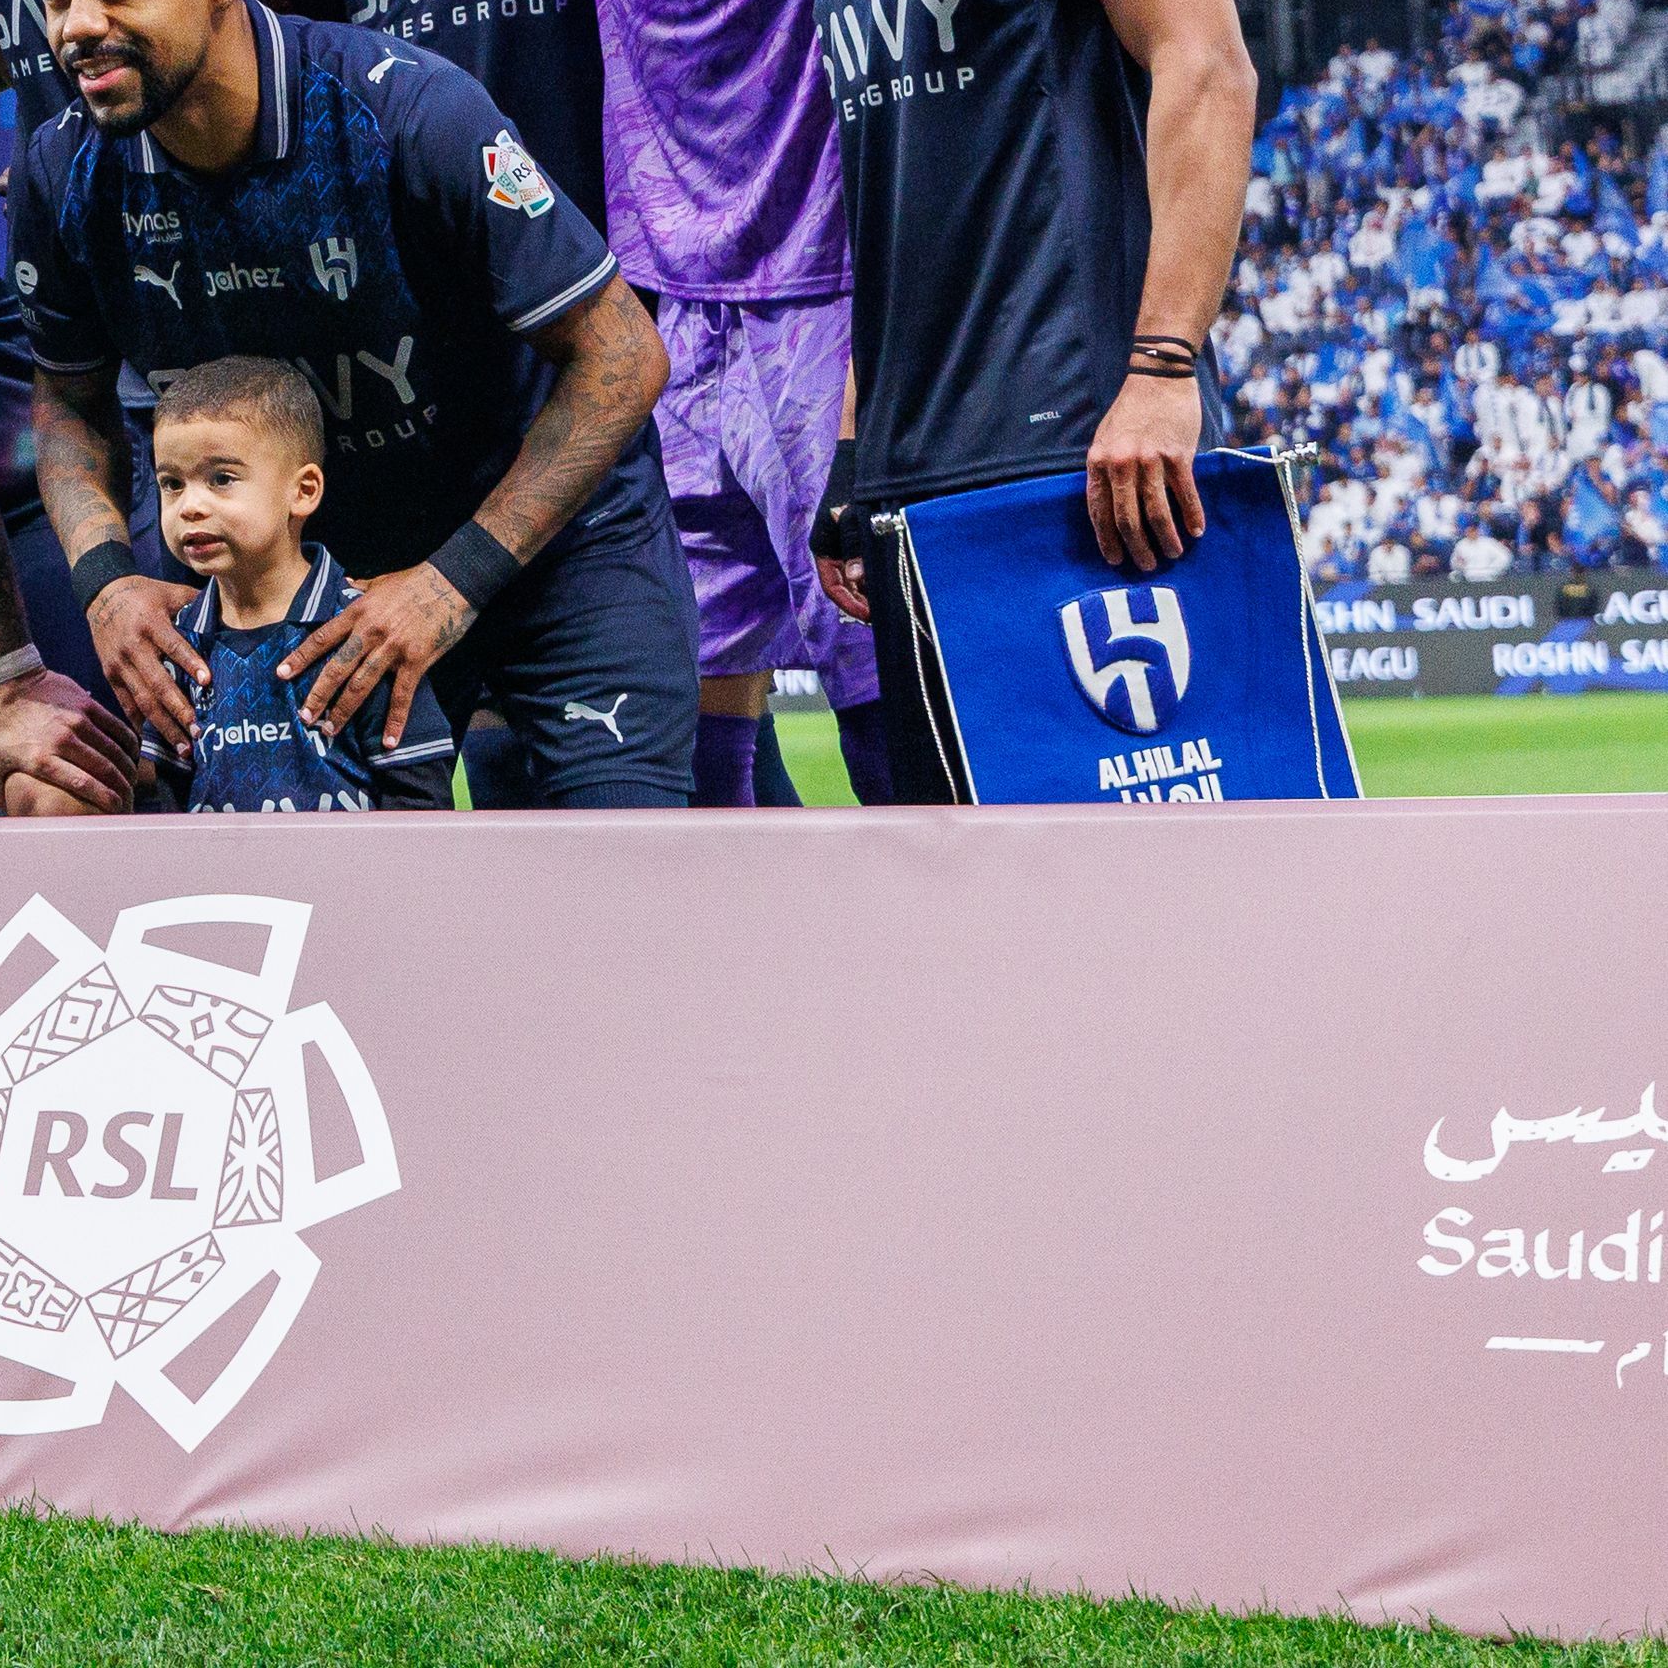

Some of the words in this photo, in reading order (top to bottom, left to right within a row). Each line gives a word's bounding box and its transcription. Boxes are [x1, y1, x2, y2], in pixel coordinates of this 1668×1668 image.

[383, 12, 435, 39] MES
[11, 53, 53, 79] AME
[511, 162, 532, 183] RS
[206, 262, 285, 297] jahez
[337, 403, 438, 454] ROUP
[1315, 600, 1397, 634] SHN
[1412, 594, 1536, 632] SAUDI
[1331, 646, 1419, 682] EAGU
[1492, 640, 1610, 678] ROSHN
[212, 718, 293, 752] jahez
[1098, 737, 1223, 791] ALHILAL
[22, 1110, 199, 1201] RSL
[1416, 1205, 1664, 1283] Saudi
